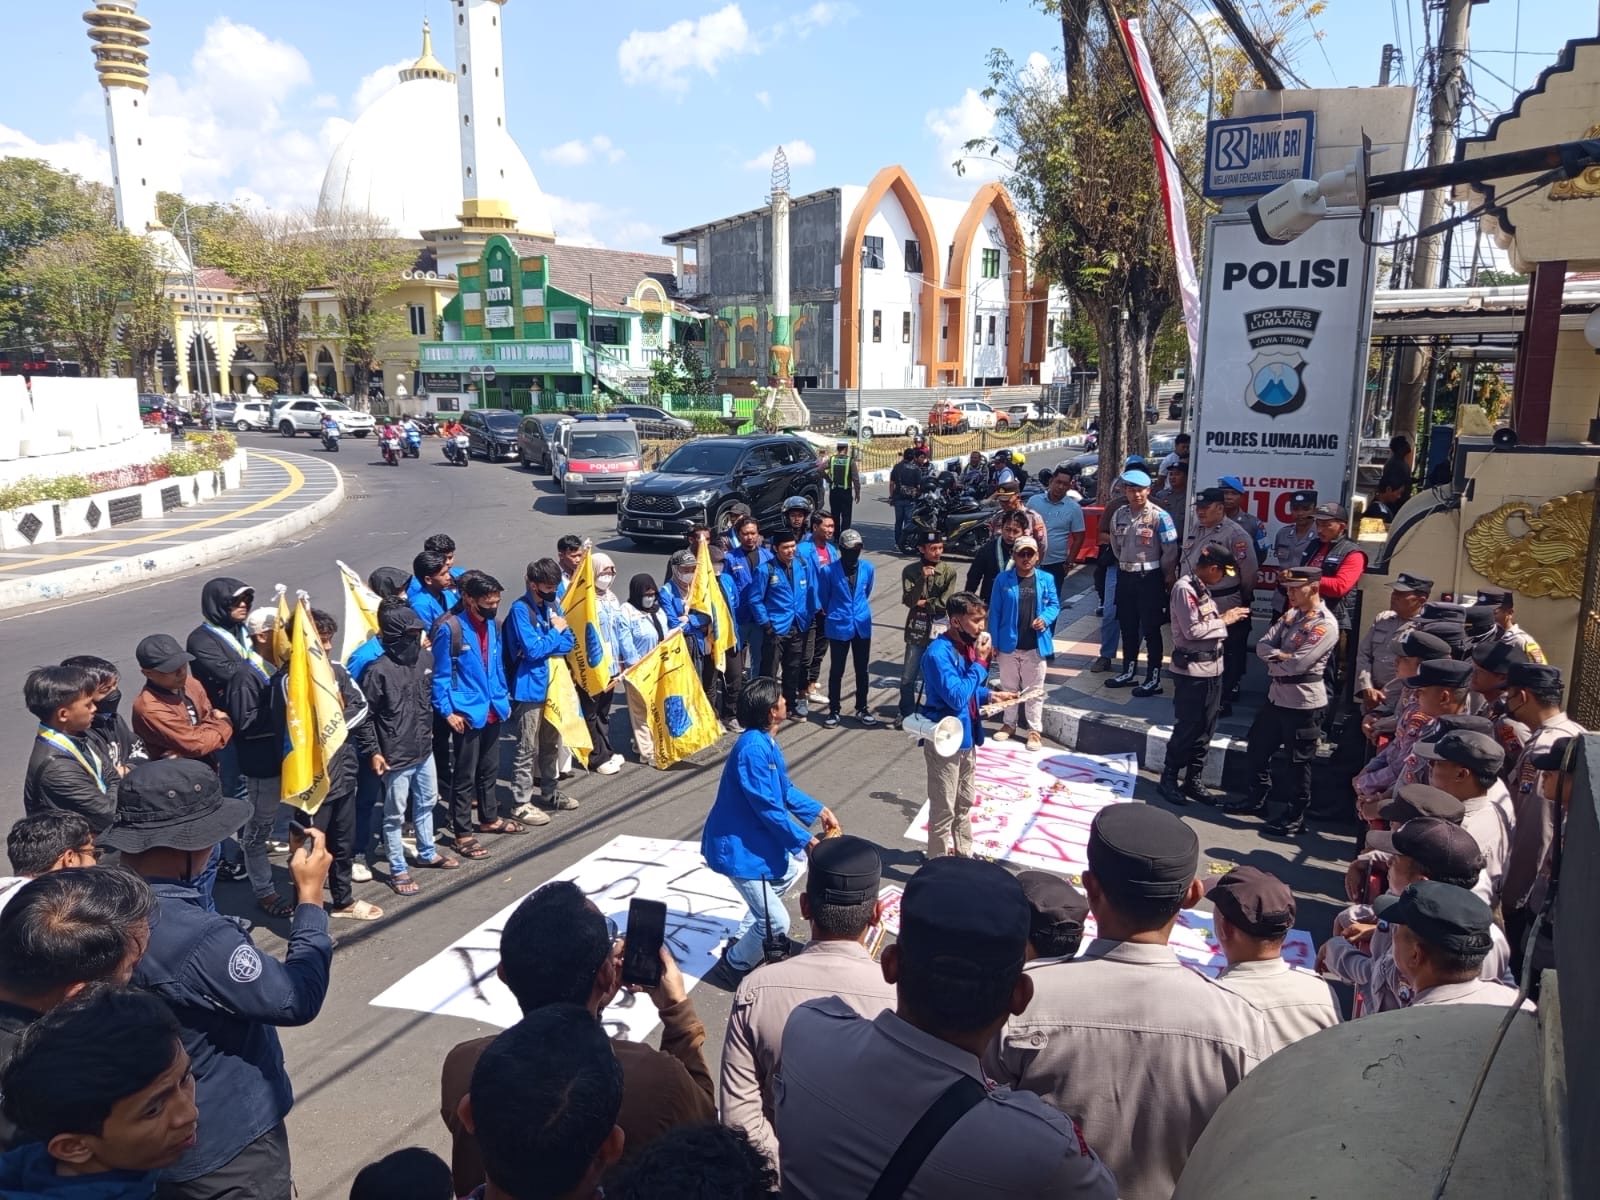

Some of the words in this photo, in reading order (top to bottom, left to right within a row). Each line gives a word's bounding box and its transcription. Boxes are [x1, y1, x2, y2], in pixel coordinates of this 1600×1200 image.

[1251, 131, 1281, 160] BANK
[1283, 128, 1302, 157] BRI
[1240, 171, 1263, 183] DENGAN
[1263, 168, 1286, 181] SETULUS
[1222, 258, 1349, 290] POLISI
[1253, 310, 1312, 321] POLRES
[1251, 318, 1313, 330] LUMAJANG
[1255, 336, 1278, 346] JAWA
[1280, 336, 1305, 345] TIMUR
[1205, 431, 1258, 447] POLRES
[1261, 432, 1339, 450] LUMAJANG
[1258, 477, 1315, 489] CENTER
